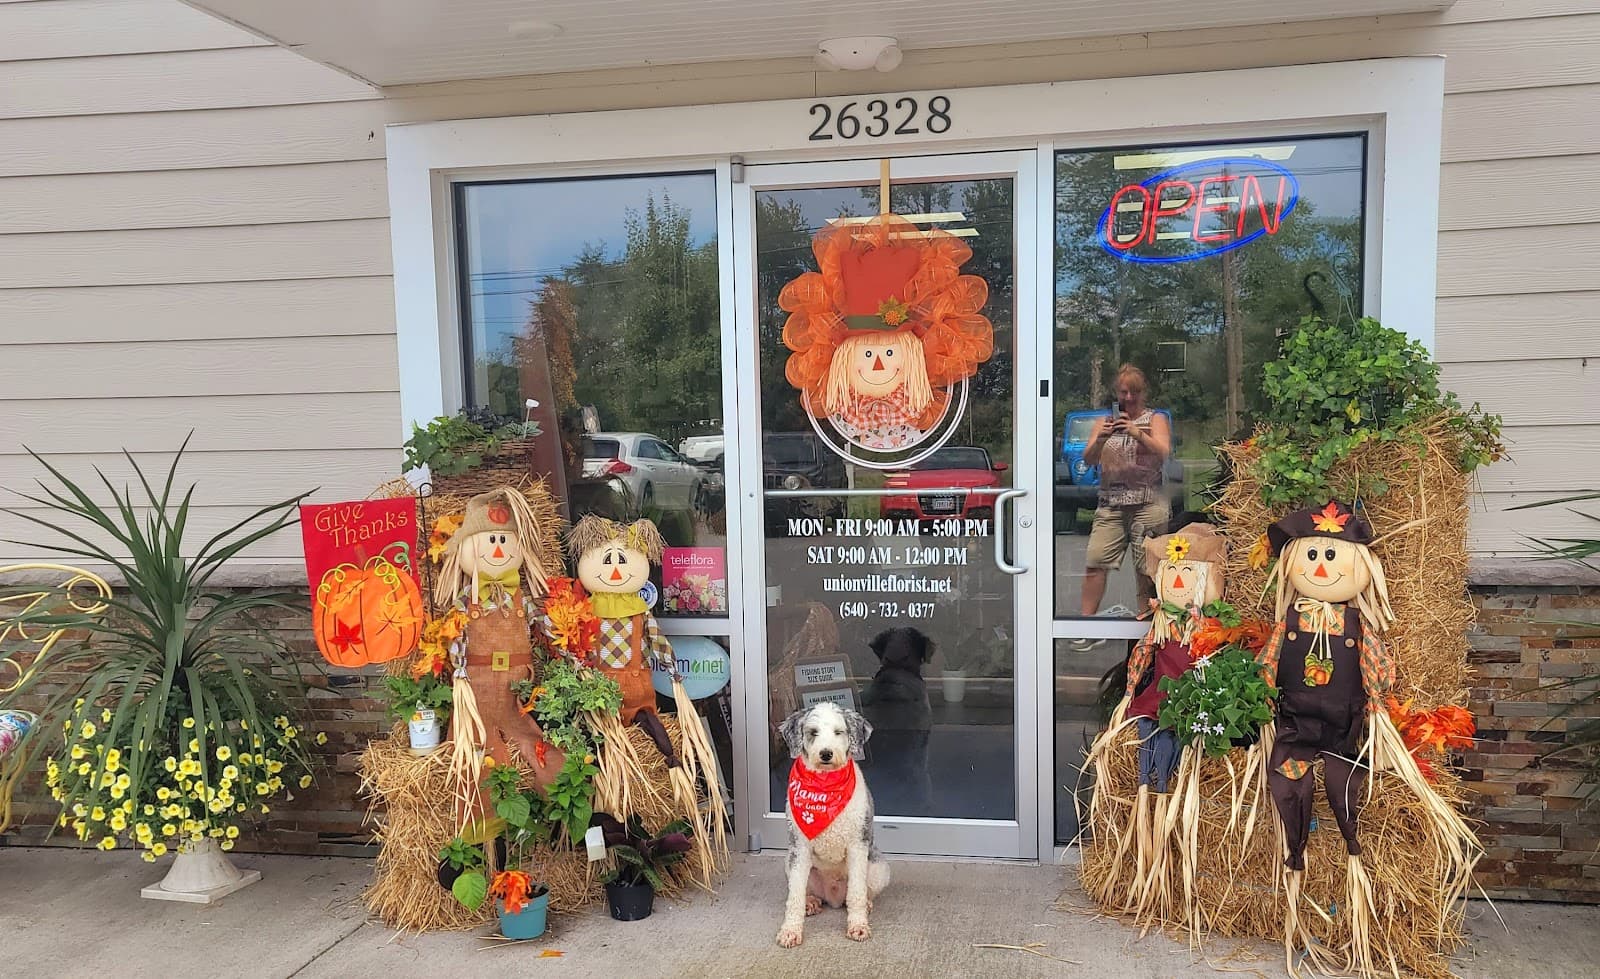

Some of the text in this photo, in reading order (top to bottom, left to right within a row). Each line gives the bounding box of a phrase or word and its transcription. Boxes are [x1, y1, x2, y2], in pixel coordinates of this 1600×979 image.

[808, 95, 952, 141] 26328
[1106, 174, 1286, 250] OPEN
[314, 503, 365, 532] Give
[788, 518, 824, 537] MON
[836, 519, 861, 537] FRI
[865, 519, 893, 537] 9:00
[896, 519, 920, 537] AM
[932, 519, 961, 537] 5:00
[964, 519, 988, 537] PM
[329, 511, 408, 548] Thanks
[807, 546, 834, 565] SAT
[837, 547, 865, 564] 9:00
[868, 547, 892, 565] AM
[904, 547, 940, 565] 12:00
[943, 547, 967, 566] PM
[823, 574, 952, 593] unionvilleflorist.net
[839, 602, 868, 619] (540)
[879, 603, 899, 617] 732
[908, 603, 935, 618] 0377
[805, 802, 827, 813] baby
